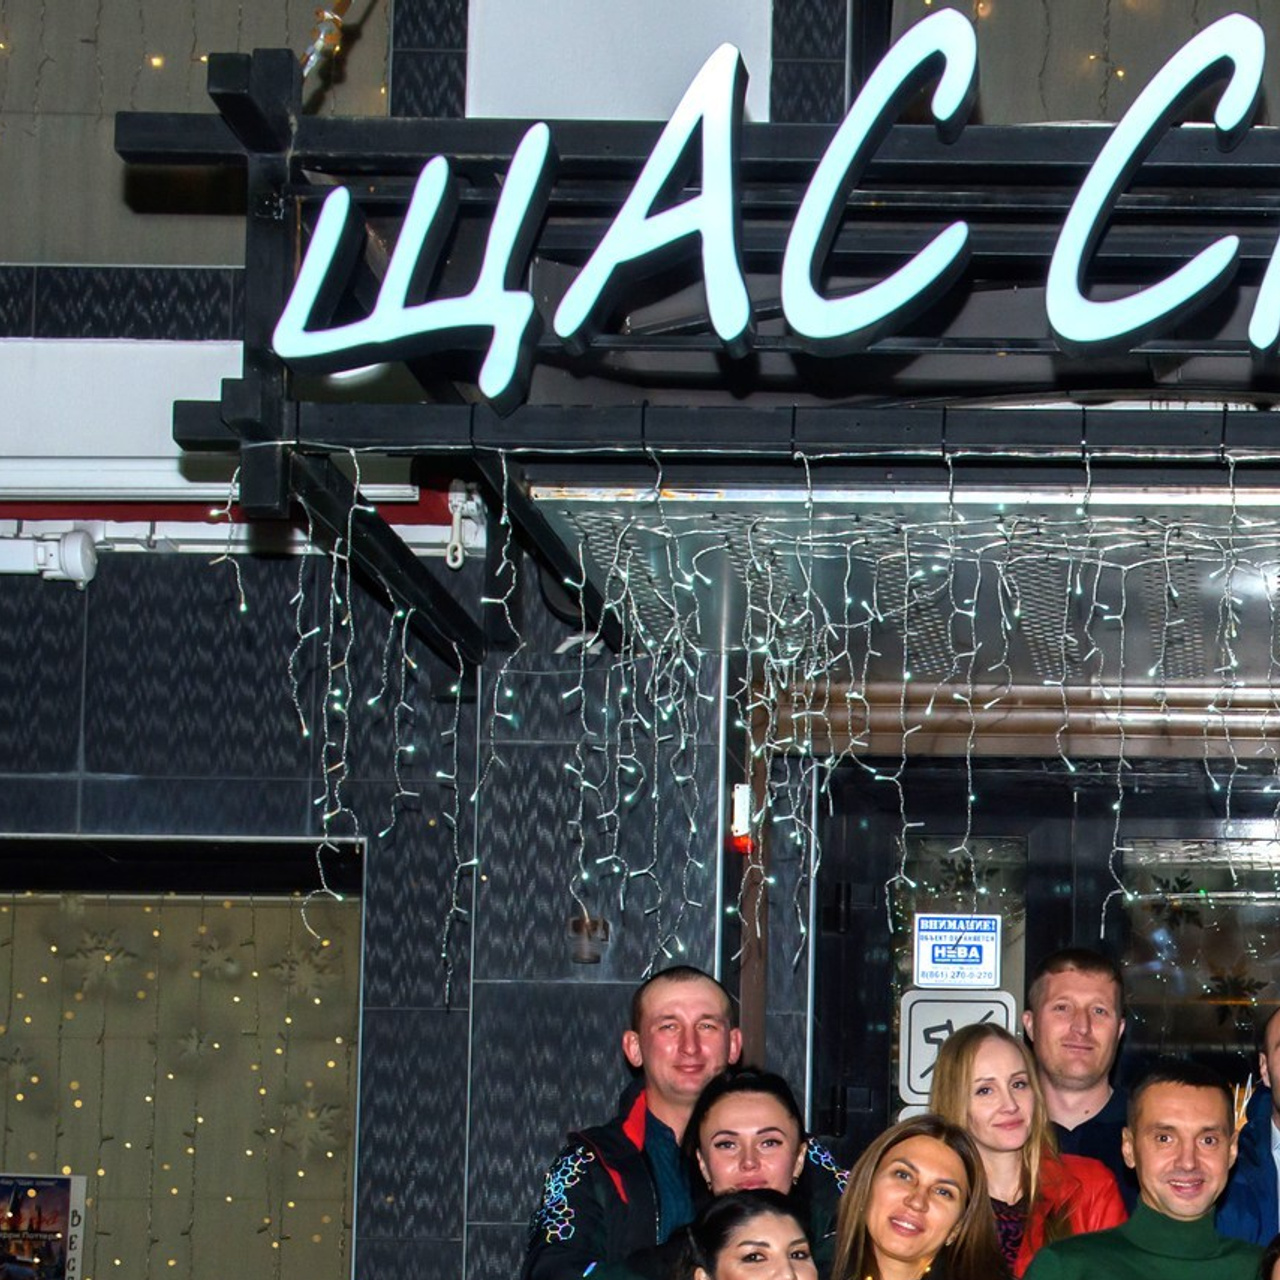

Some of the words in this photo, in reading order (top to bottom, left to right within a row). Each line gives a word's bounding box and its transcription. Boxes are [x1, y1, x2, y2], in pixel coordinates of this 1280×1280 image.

[274, 9, 975, 396] ЩАС
[920, 919, 996, 931] ВНИМАНИЕ!
[934, 946, 980, 958] НЕВА
